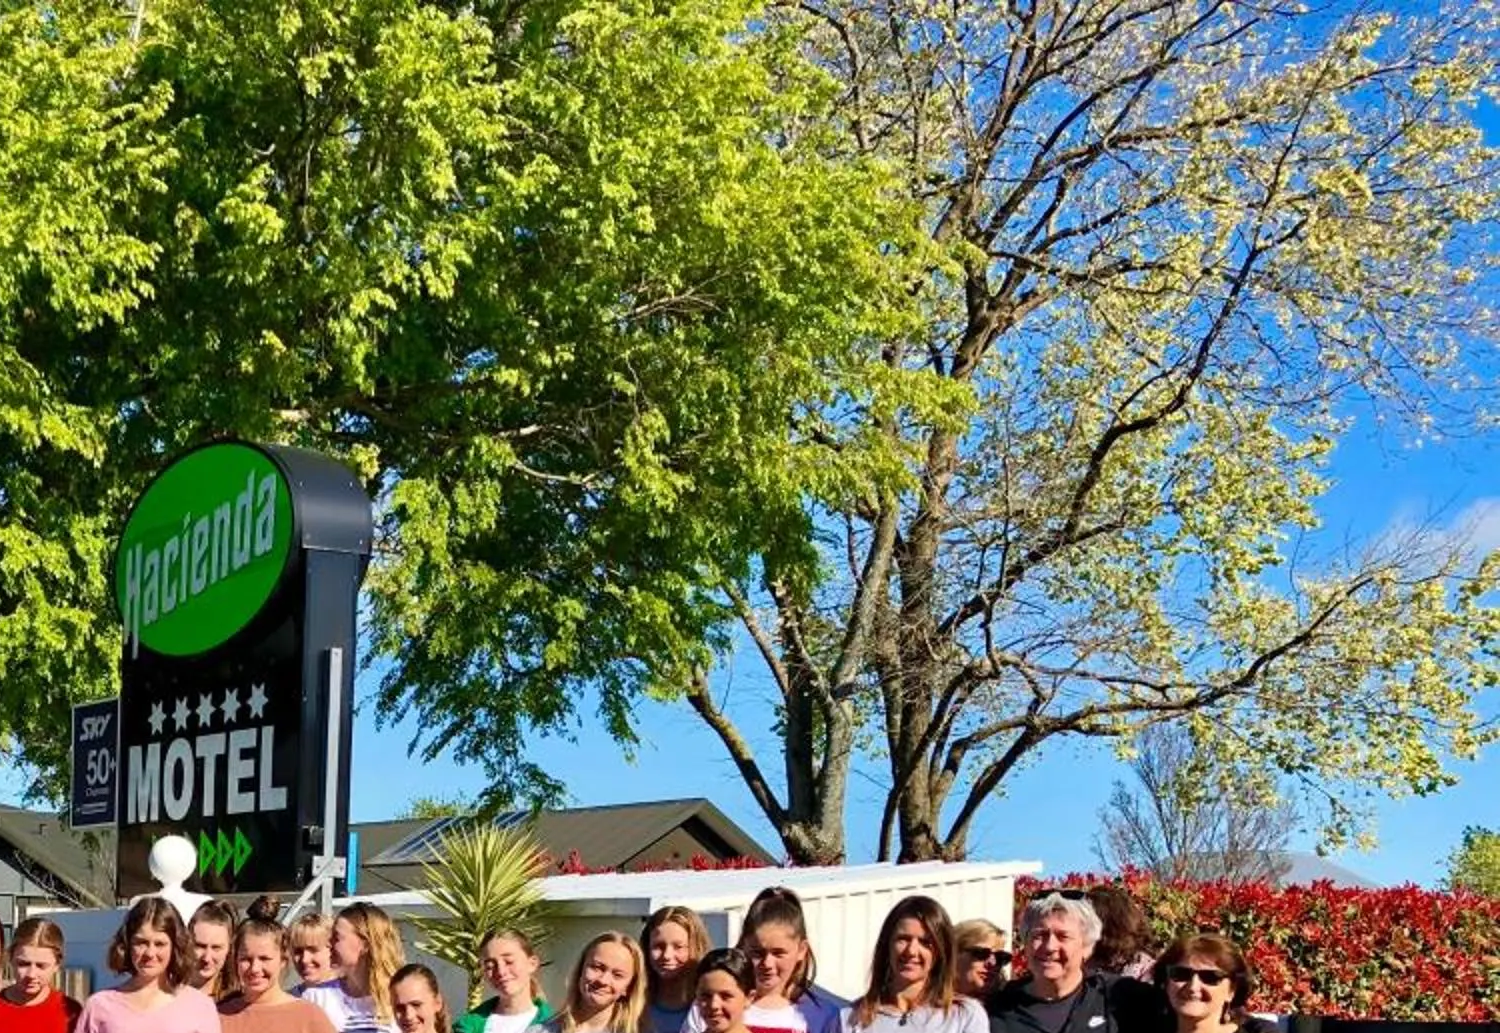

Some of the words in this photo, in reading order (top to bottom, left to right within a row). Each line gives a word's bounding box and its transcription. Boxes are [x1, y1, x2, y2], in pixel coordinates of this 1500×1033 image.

[124, 470, 277, 659] Hacienda
[79, 713, 112, 741] SKY
[85, 747, 117, 786] 50+
[127, 725, 288, 825] MOTEL
